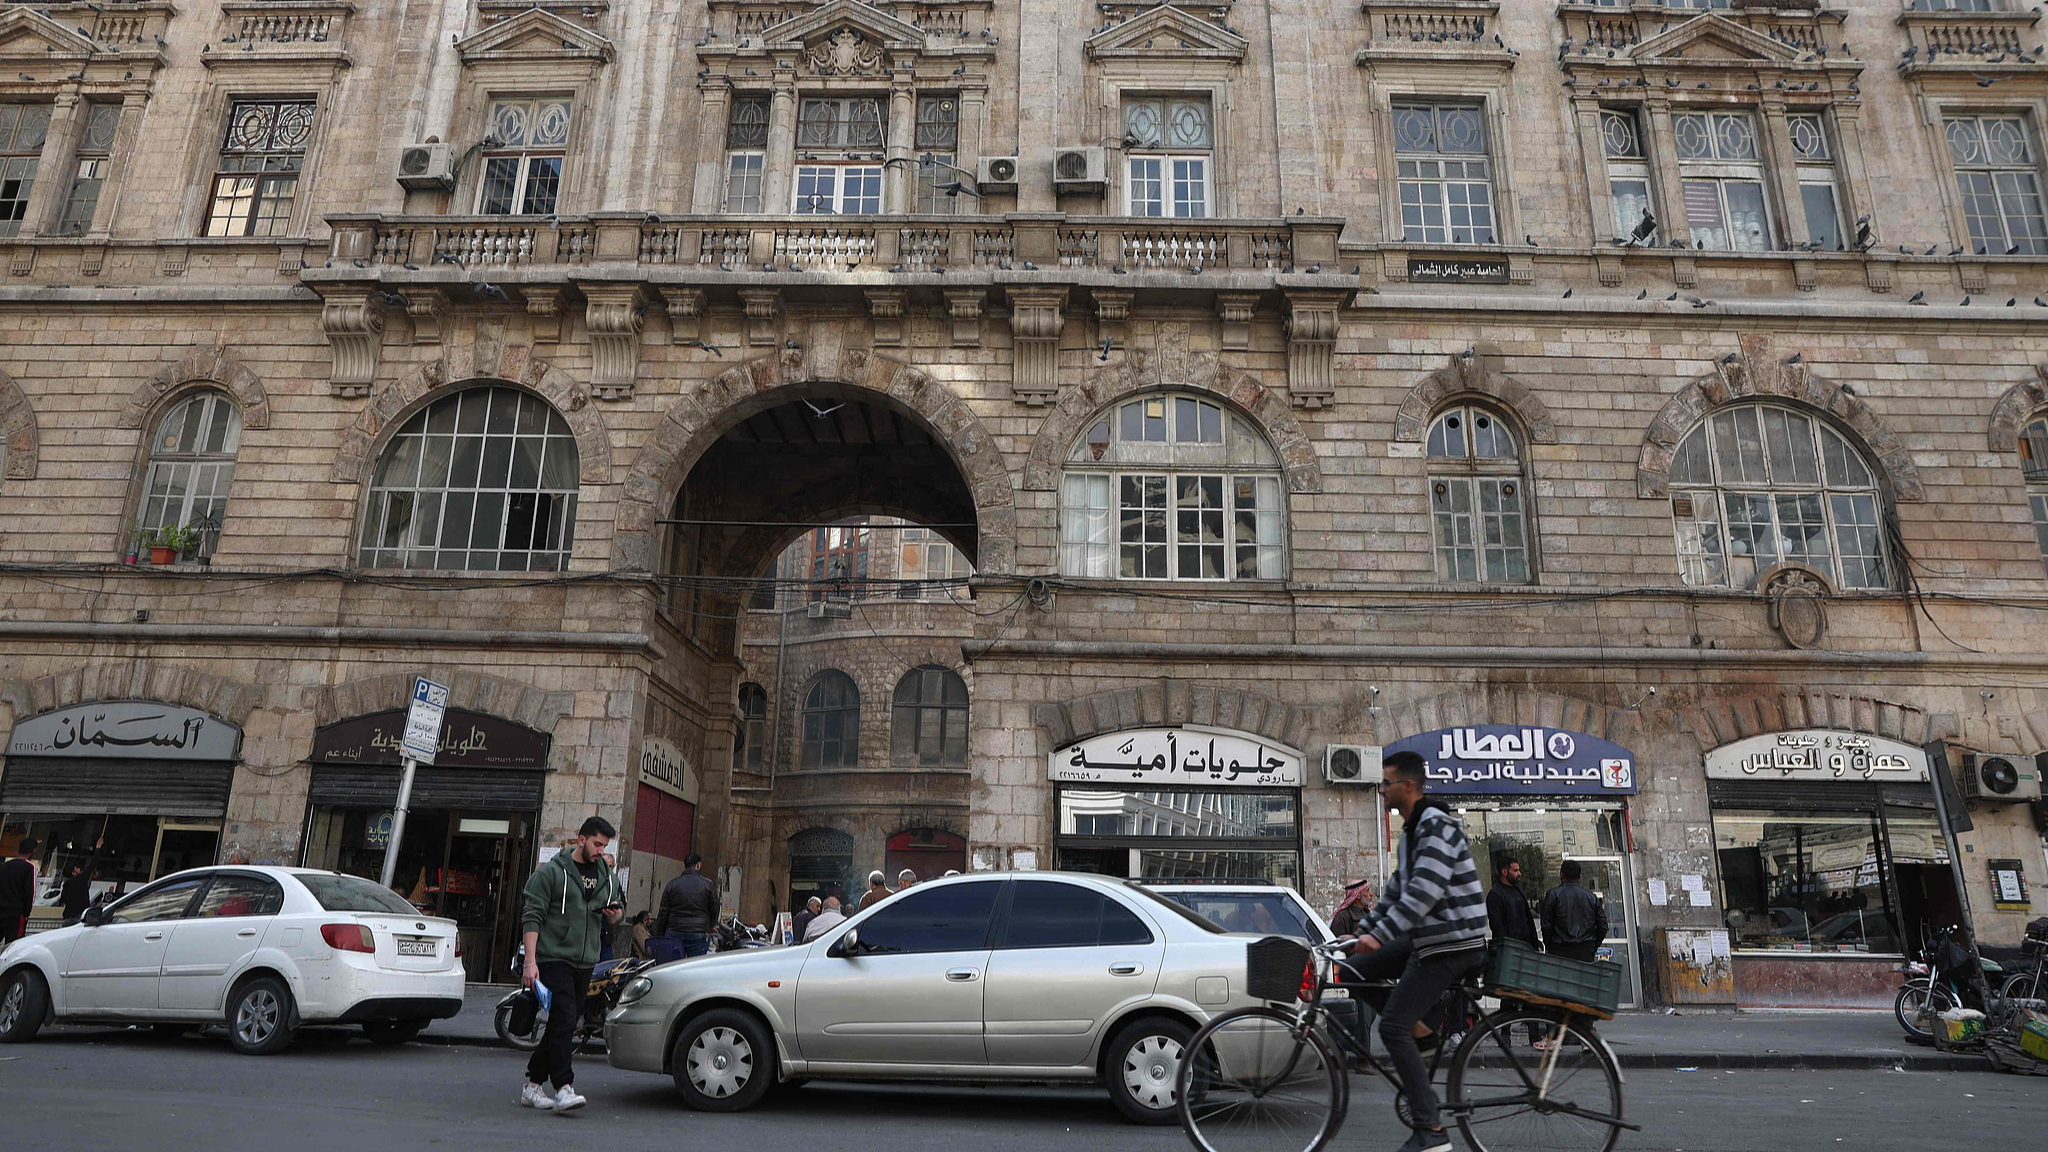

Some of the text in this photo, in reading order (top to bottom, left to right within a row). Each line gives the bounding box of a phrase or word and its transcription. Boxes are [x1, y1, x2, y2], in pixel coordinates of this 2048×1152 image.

[1412, 262, 1441, 279] الشمالي
[1441, 263, 1459, 278] كامل
[416, 681, 428, 698] P
[1438, 728, 1545, 760] العطار
[1778, 735, 1870, 750] مخبز و حلويات
[1183, 738, 1285, 780] حلويات
[1741, 747, 1911, 778] حمزة و العباس
[1059, 771, 1091, 780] ٢٢١٦٦٥٩
[1257, 772, 1295, 785] بارودي
[1502, 760, 1600, 784] صيدلية
